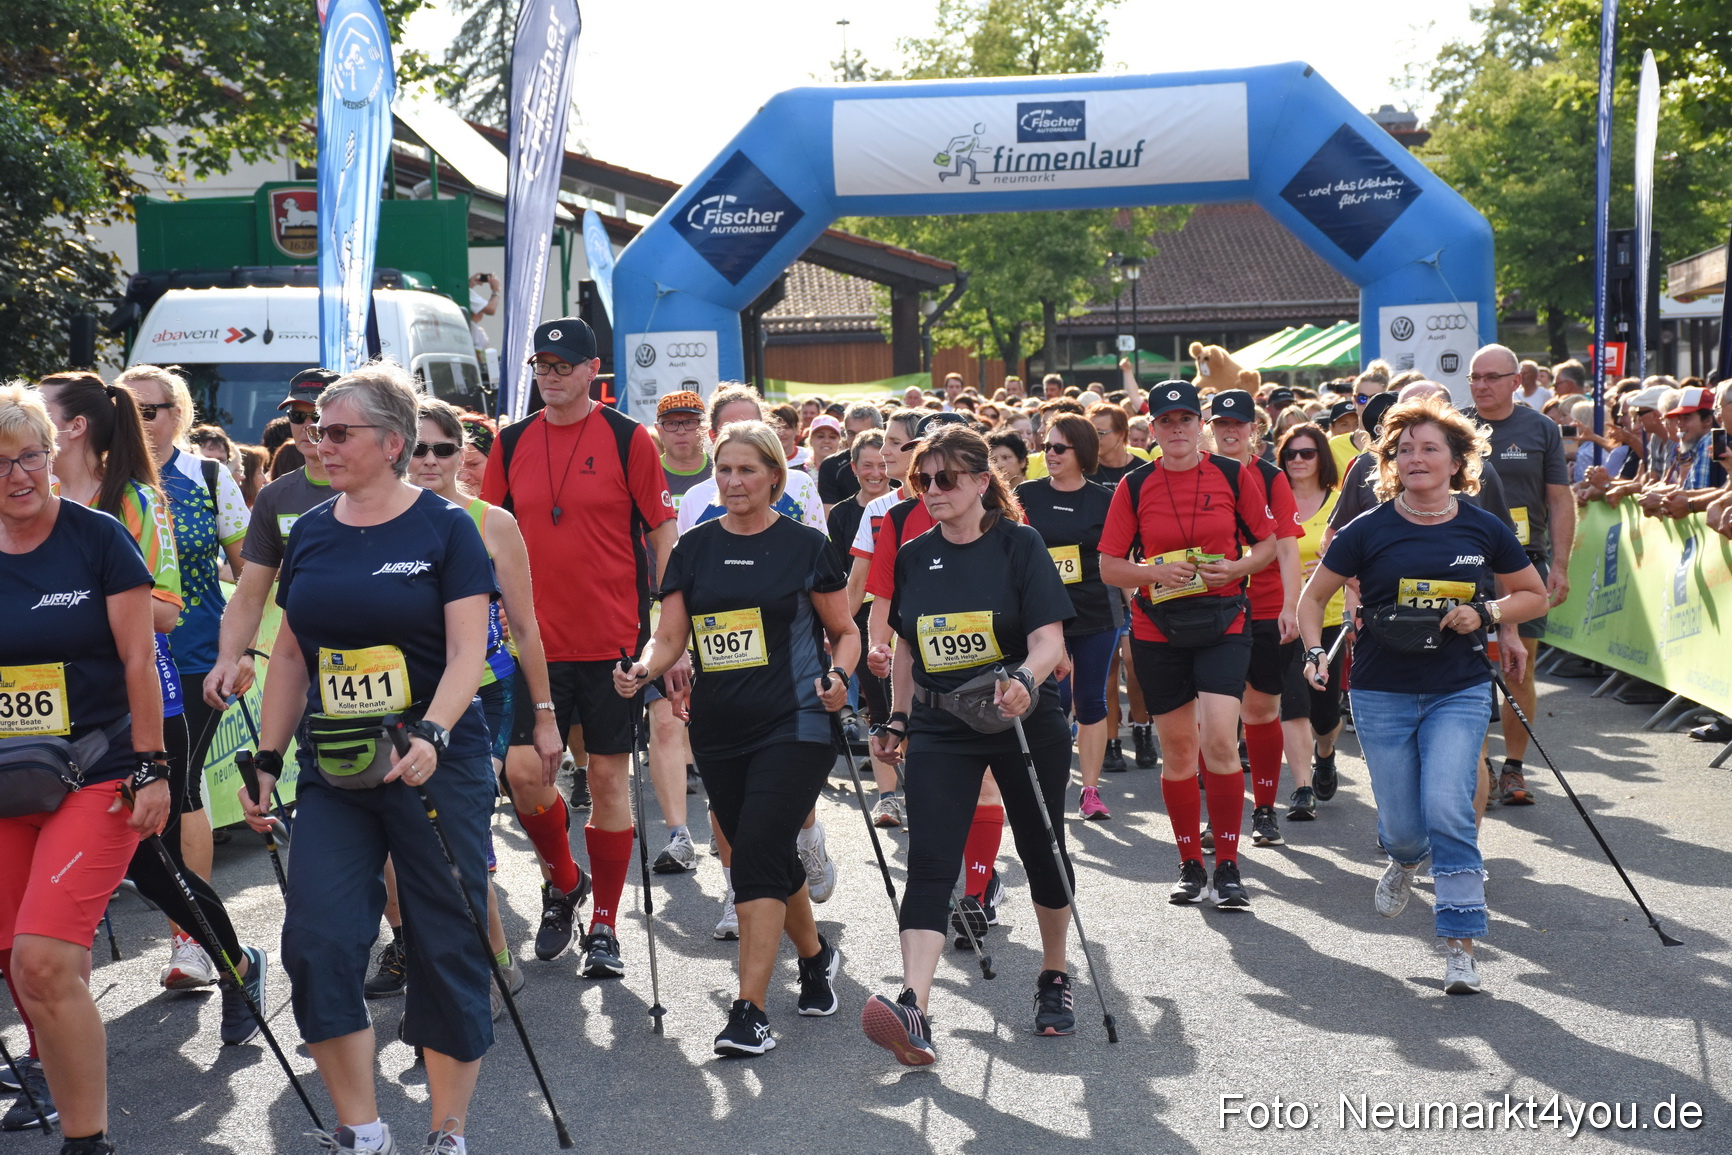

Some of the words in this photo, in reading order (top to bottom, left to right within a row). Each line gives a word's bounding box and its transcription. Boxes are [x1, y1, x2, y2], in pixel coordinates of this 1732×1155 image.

[531, 4, 560, 152] Fischer
[545, 23, 567, 144] AUTOMOBILE
[1031, 116, 1082, 128] Fischer
[993, 139, 1146, 172] firmenlauf
[993, 173, 1056, 184] neumarkt
[1309, 183, 1332, 196] und
[1334, 179, 1356, 192] das
[1357, 176, 1404, 189] Lächeln
[1338, 193, 1371, 209] fährt
[1373, 188, 1401, 199] mit!
[703, 207, 785, 225] Fischer
[710, 225, 778, 234] AUTOMOBILE
[289, 241, 315, 251] 1628
[152, 327, 221, 344] abavent
[1443, 357, 1458, 370] FIAT
[635, 398, 659, 406] SEA
[585, 456, 595, 469] 4
[1203, 494, 1211, 507] 7
[372, 562, 415, 576] JURA
[1449, 555, 1479, 567] JURA
[31, 592, 73, 610] JURA
[703, 630, 753, 655] 1967
[928, 633, 987, 656] 1999
[381, 663, 400, 672] 2019
[328, 672, 392, 701] 1411
[359, 700, 386, 708] Renate
[1507, 694, 1528, 722] LEKI
[136, 762, 149, 782] LEKI
[173, 872, 194, 901] LEKI
